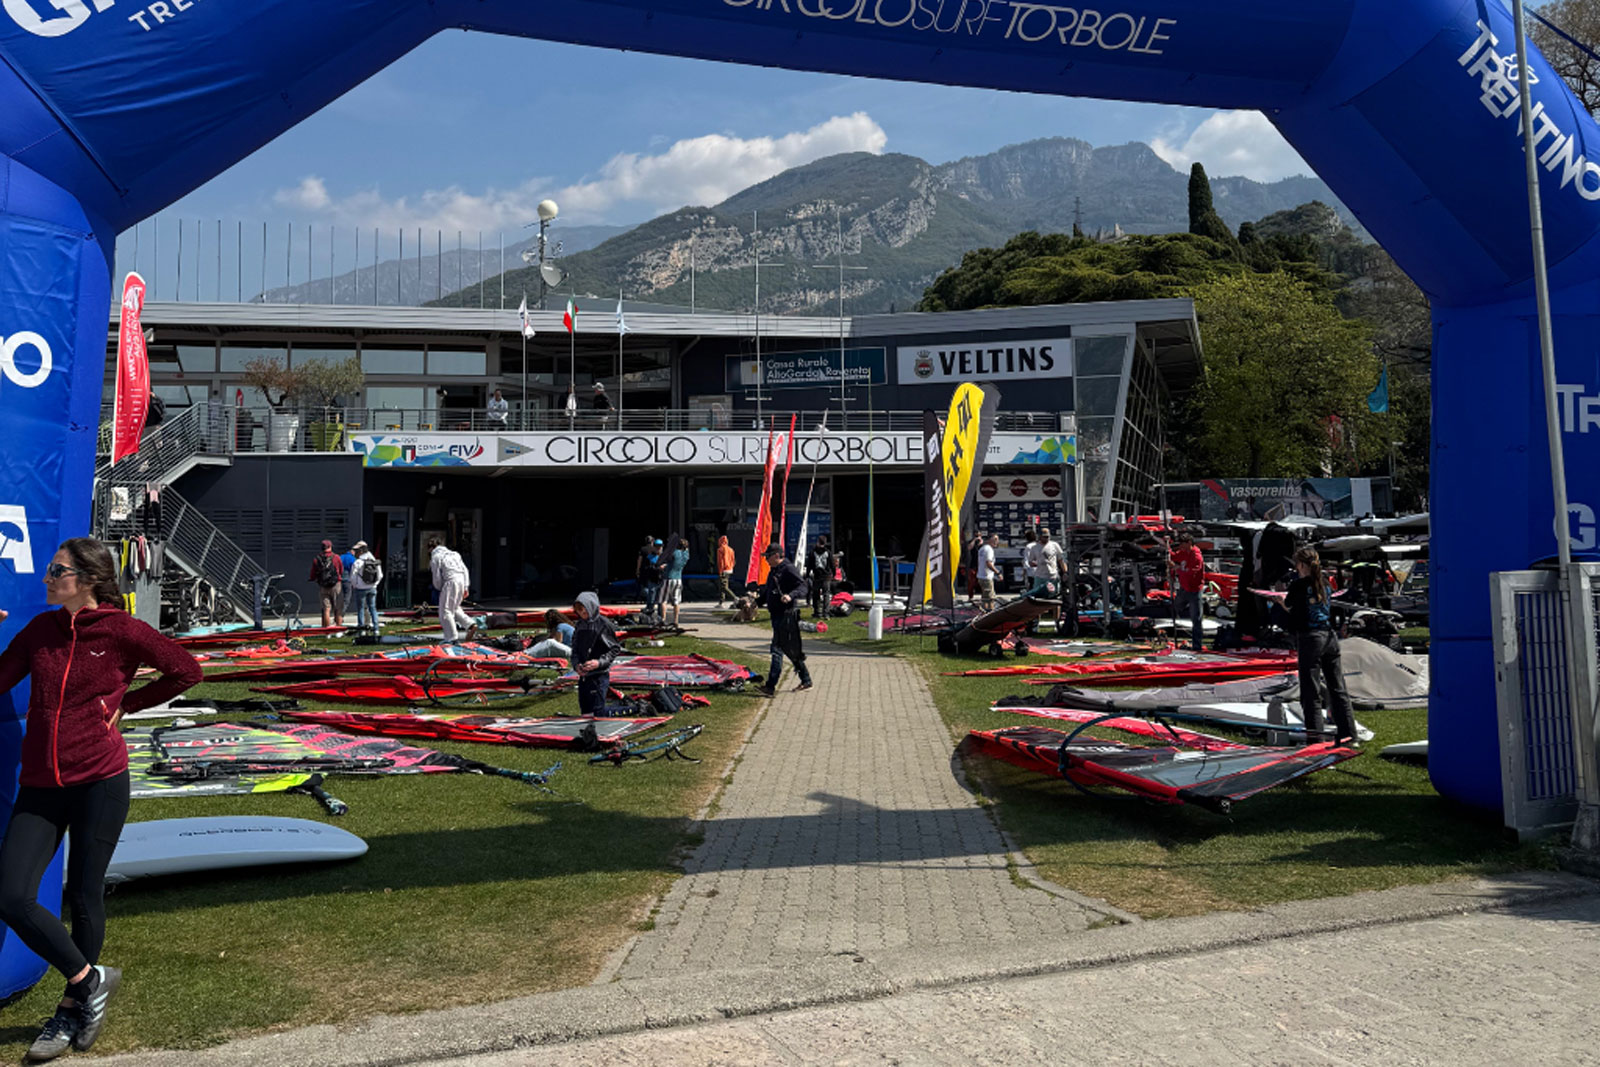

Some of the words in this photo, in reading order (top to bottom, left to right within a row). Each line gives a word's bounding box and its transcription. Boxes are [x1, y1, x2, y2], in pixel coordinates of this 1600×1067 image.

[1003, 1, 1177, 54] TORBOLE
[938, 347, 1055, 376] VELTINS
[449, 444, 475, 457] FIV
[545, 436, 697, 463] CIRCOLO
[789, 436, 923, 463] TORBOLE
